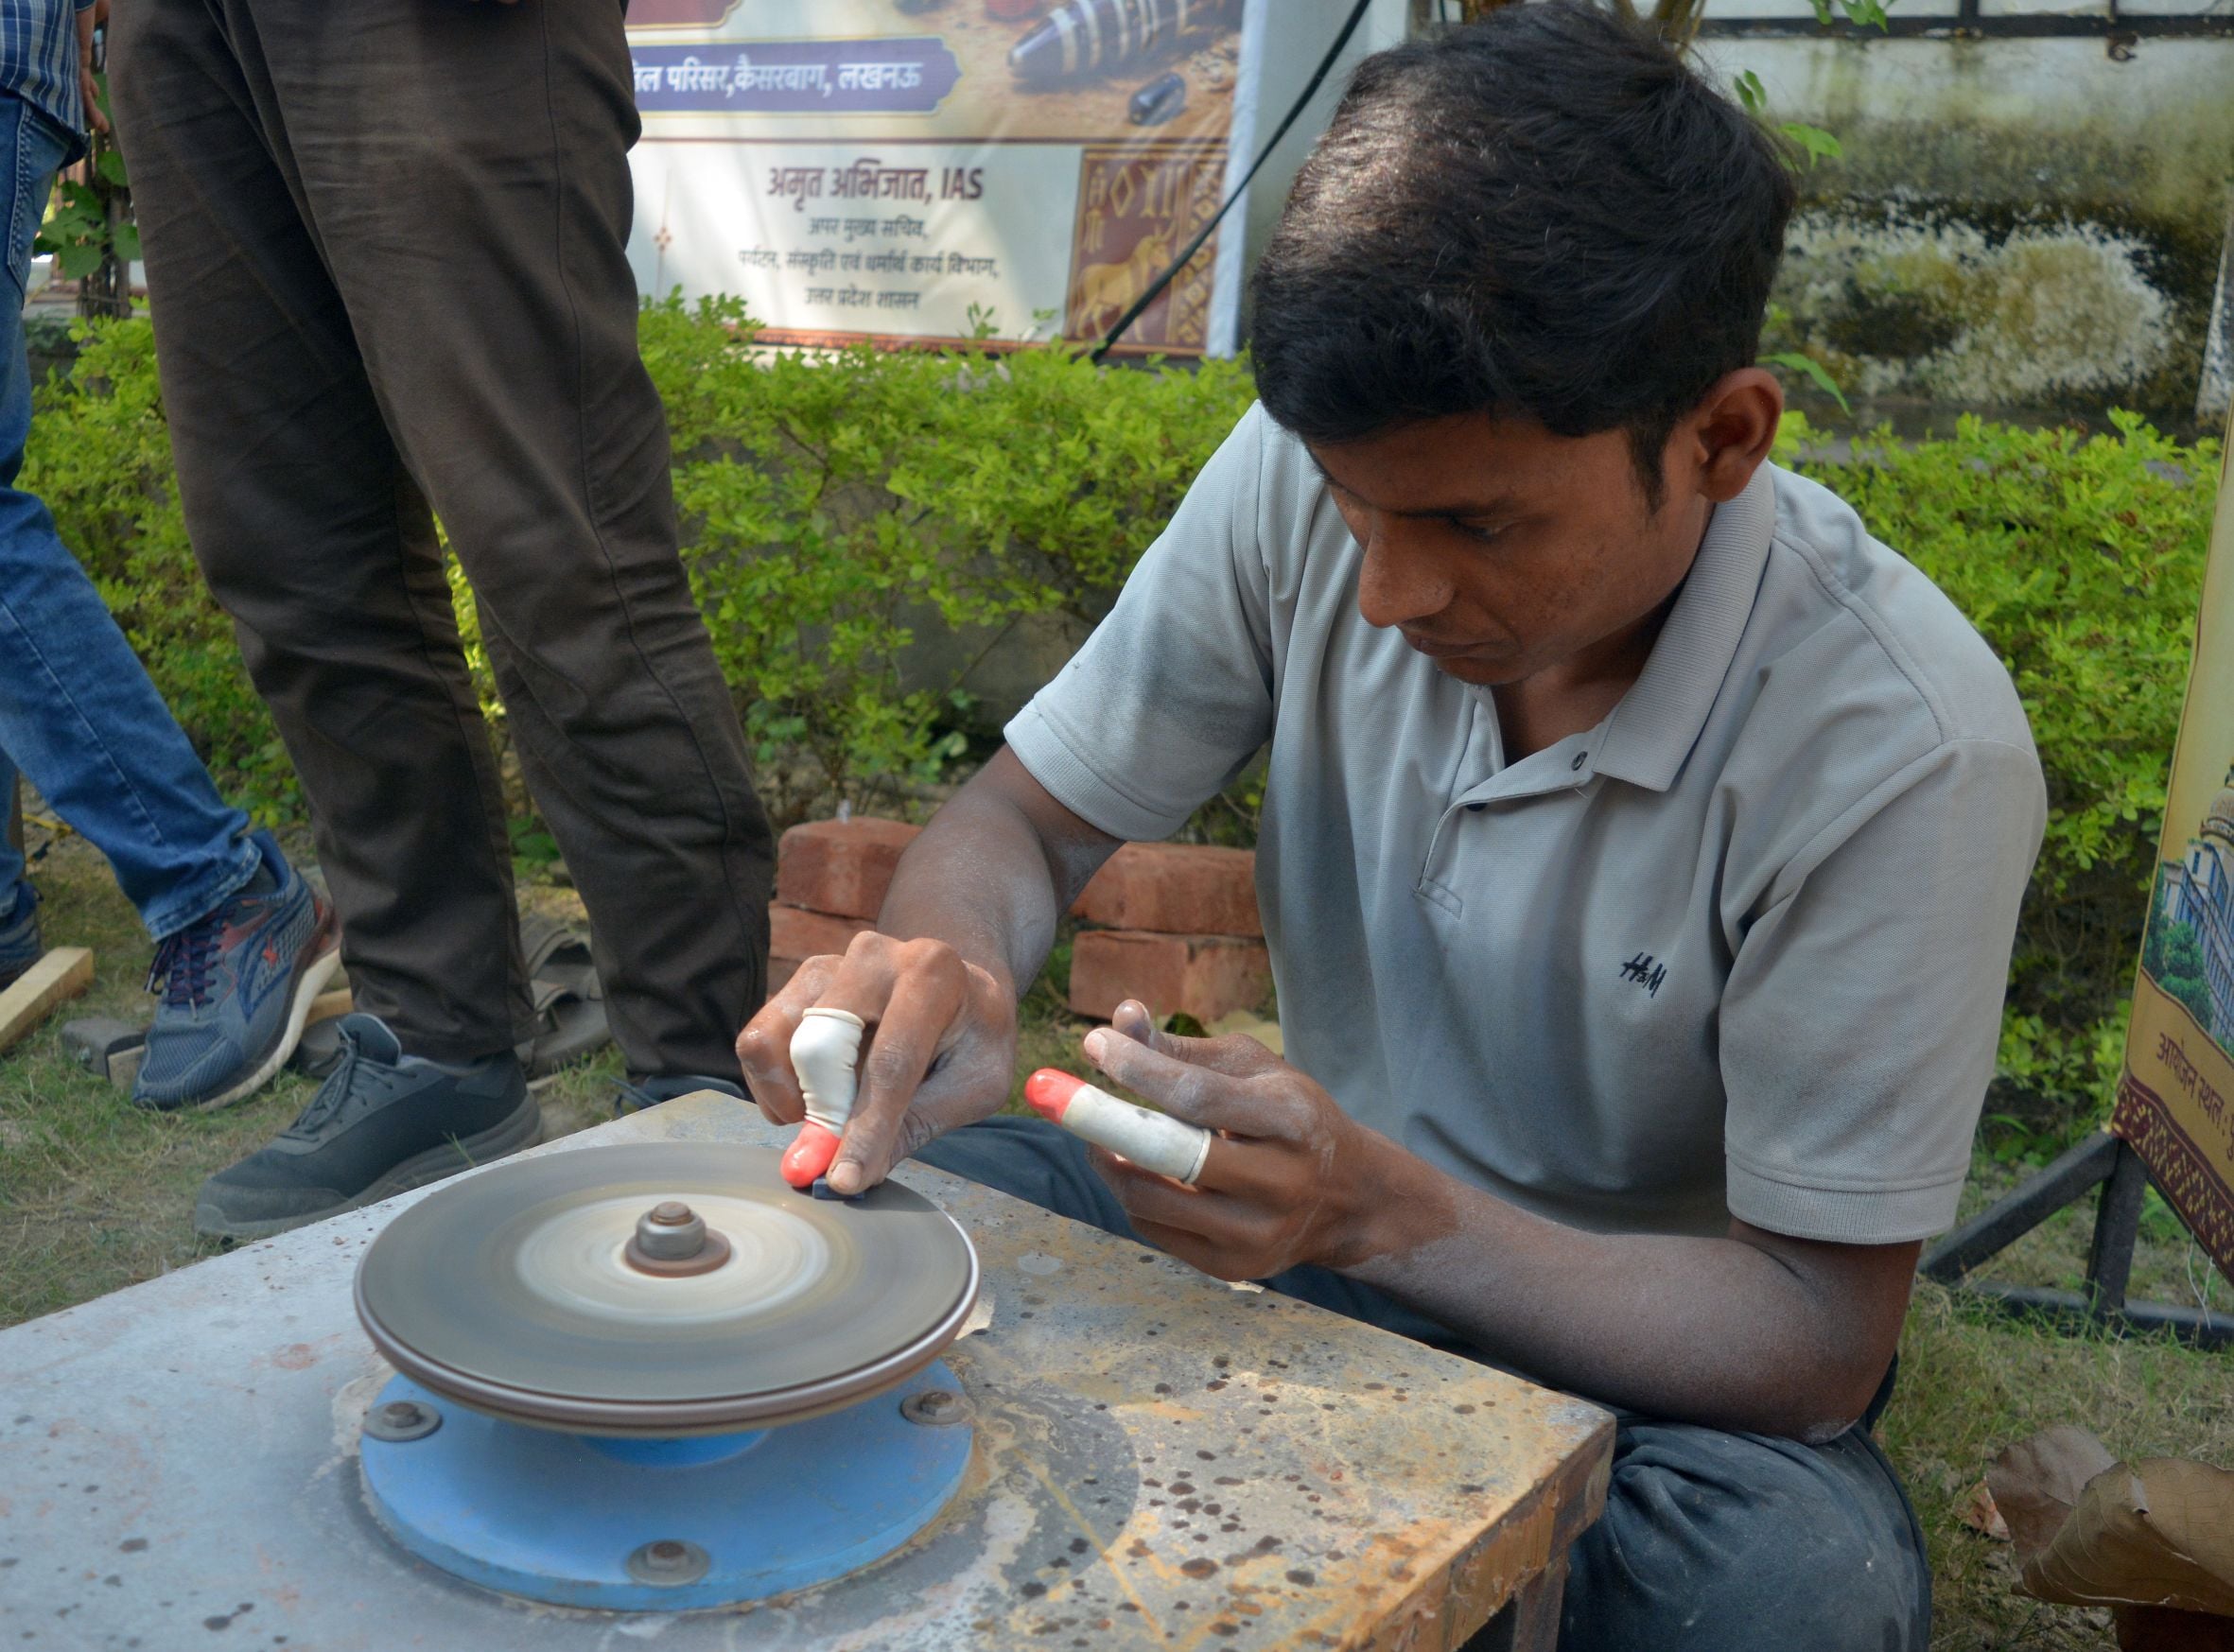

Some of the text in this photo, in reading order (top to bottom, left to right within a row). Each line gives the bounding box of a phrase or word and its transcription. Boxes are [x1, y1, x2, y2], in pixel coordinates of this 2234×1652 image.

[837, 61, 924, 91] लखनऊ
[767, 157, 985, 212] अमृत अभिजात, IAS
[808, 217, 840, 235] अपर
[843, 217, 878, 243] मुख्य
